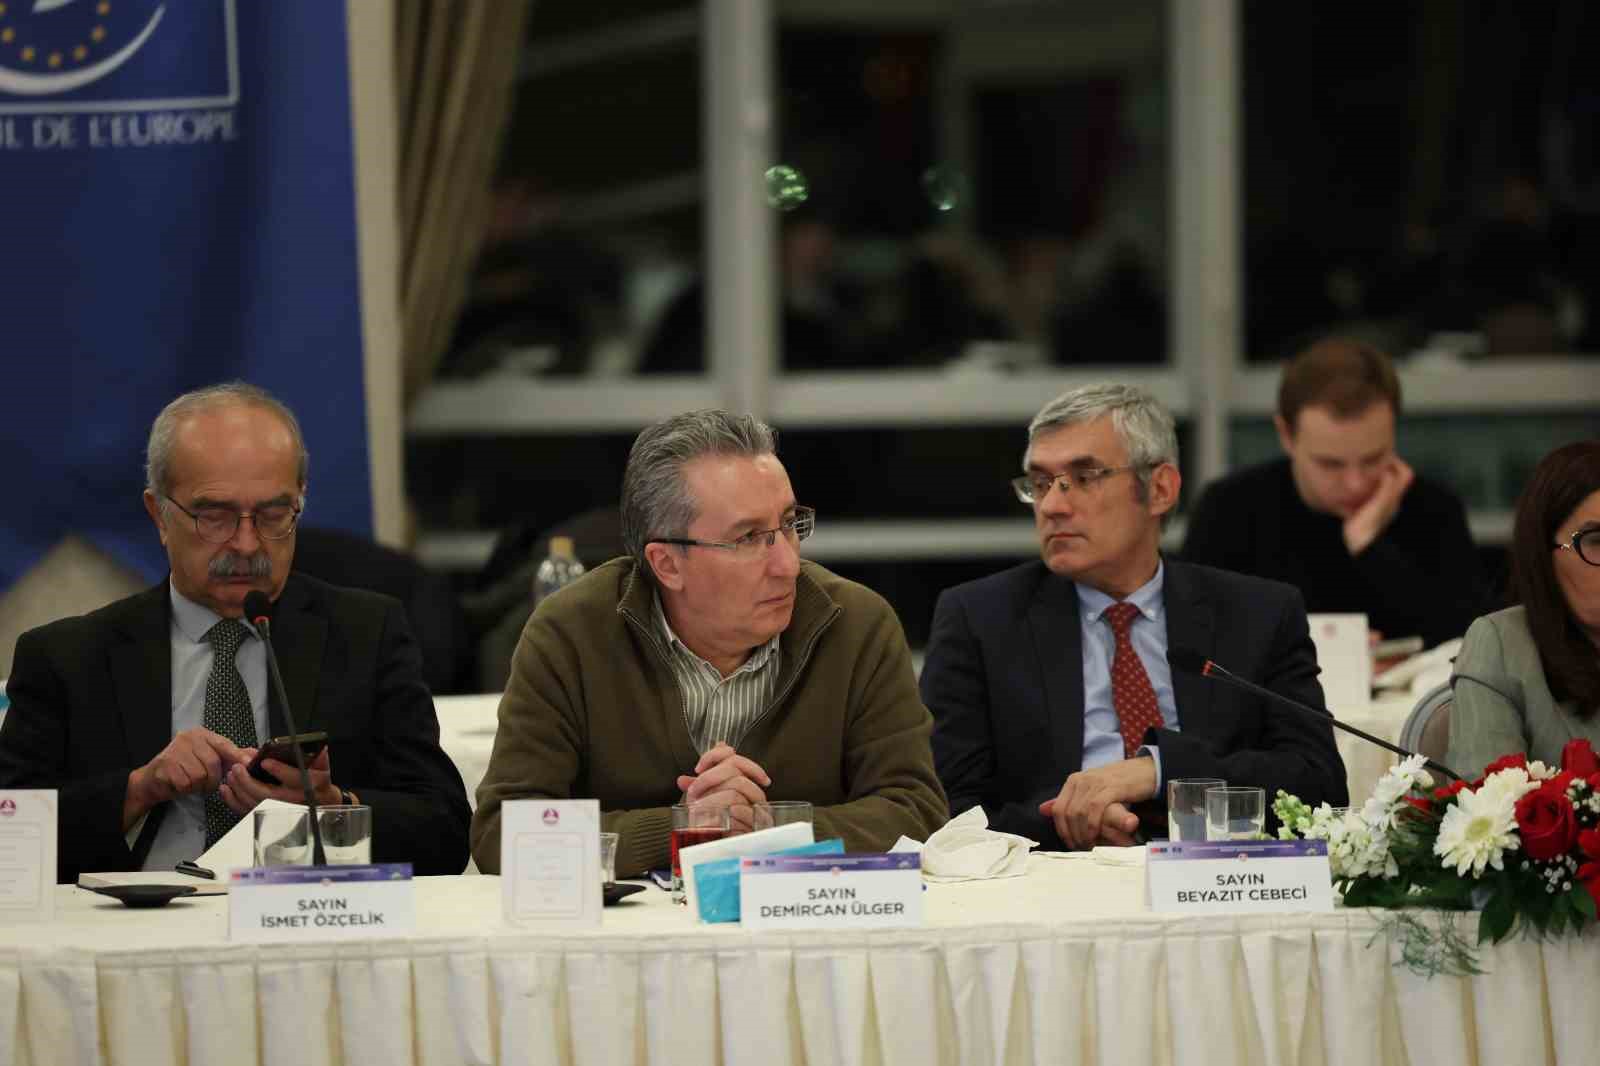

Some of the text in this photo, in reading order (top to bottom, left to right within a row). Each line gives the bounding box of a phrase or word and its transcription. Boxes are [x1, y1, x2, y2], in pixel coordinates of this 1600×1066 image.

[33, 115, 77, 148] DE
[1216, 873, 1264, 886] SAYIN
[807, 888, 856, 900] SAYIN
[1177, 885, 1307, 903] BEYAZIT CEBECİ
[297, 897, 348, 912] SAYIN
[760, 899, 905, 918] DEMİRCAN ÜLGER
[261, 910, 384, 929] İSMET ÖZÇELİK
